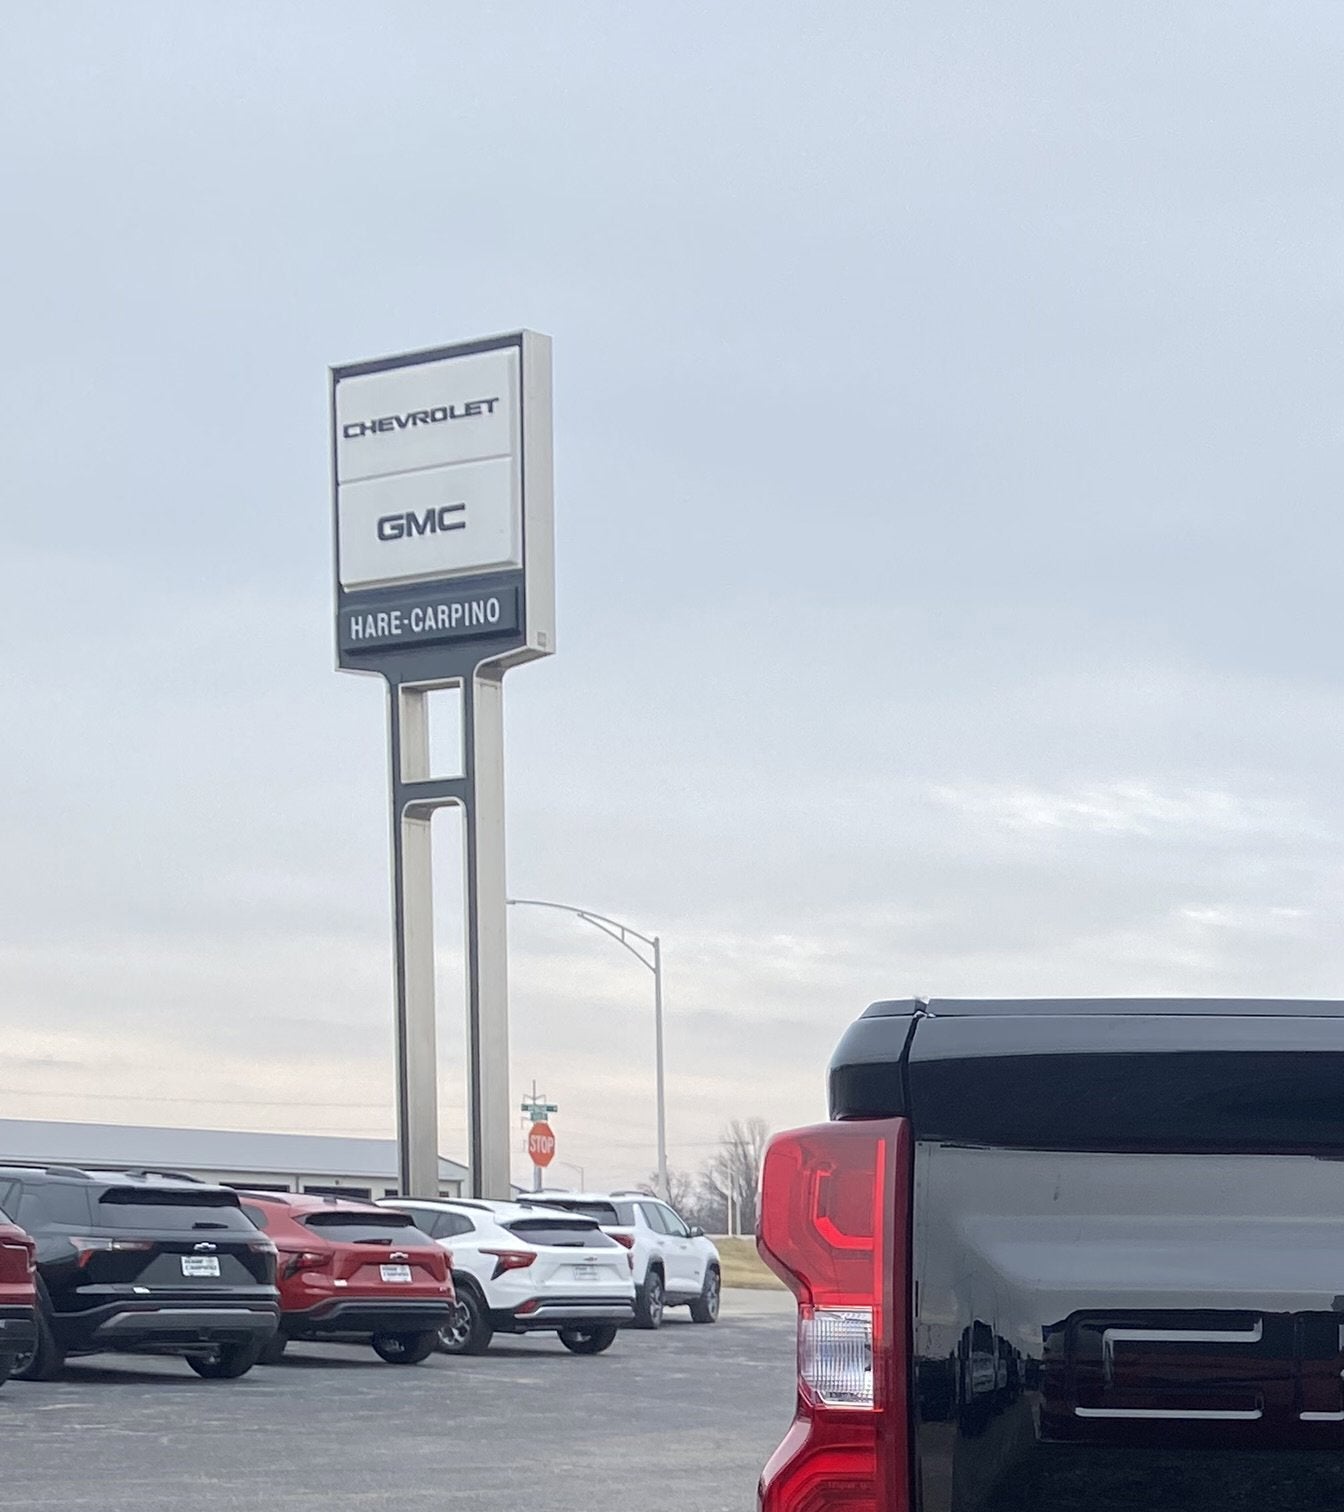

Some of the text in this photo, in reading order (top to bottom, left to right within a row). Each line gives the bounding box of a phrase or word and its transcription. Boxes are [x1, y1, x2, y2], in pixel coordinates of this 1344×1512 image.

[342, 397, 499, 439] CHEVROLET
[376, 502, 466, 541] GMC
[350, 597, 500, 640] HARE-CARPINO
[530, 1135, 553, 1153] STOP
